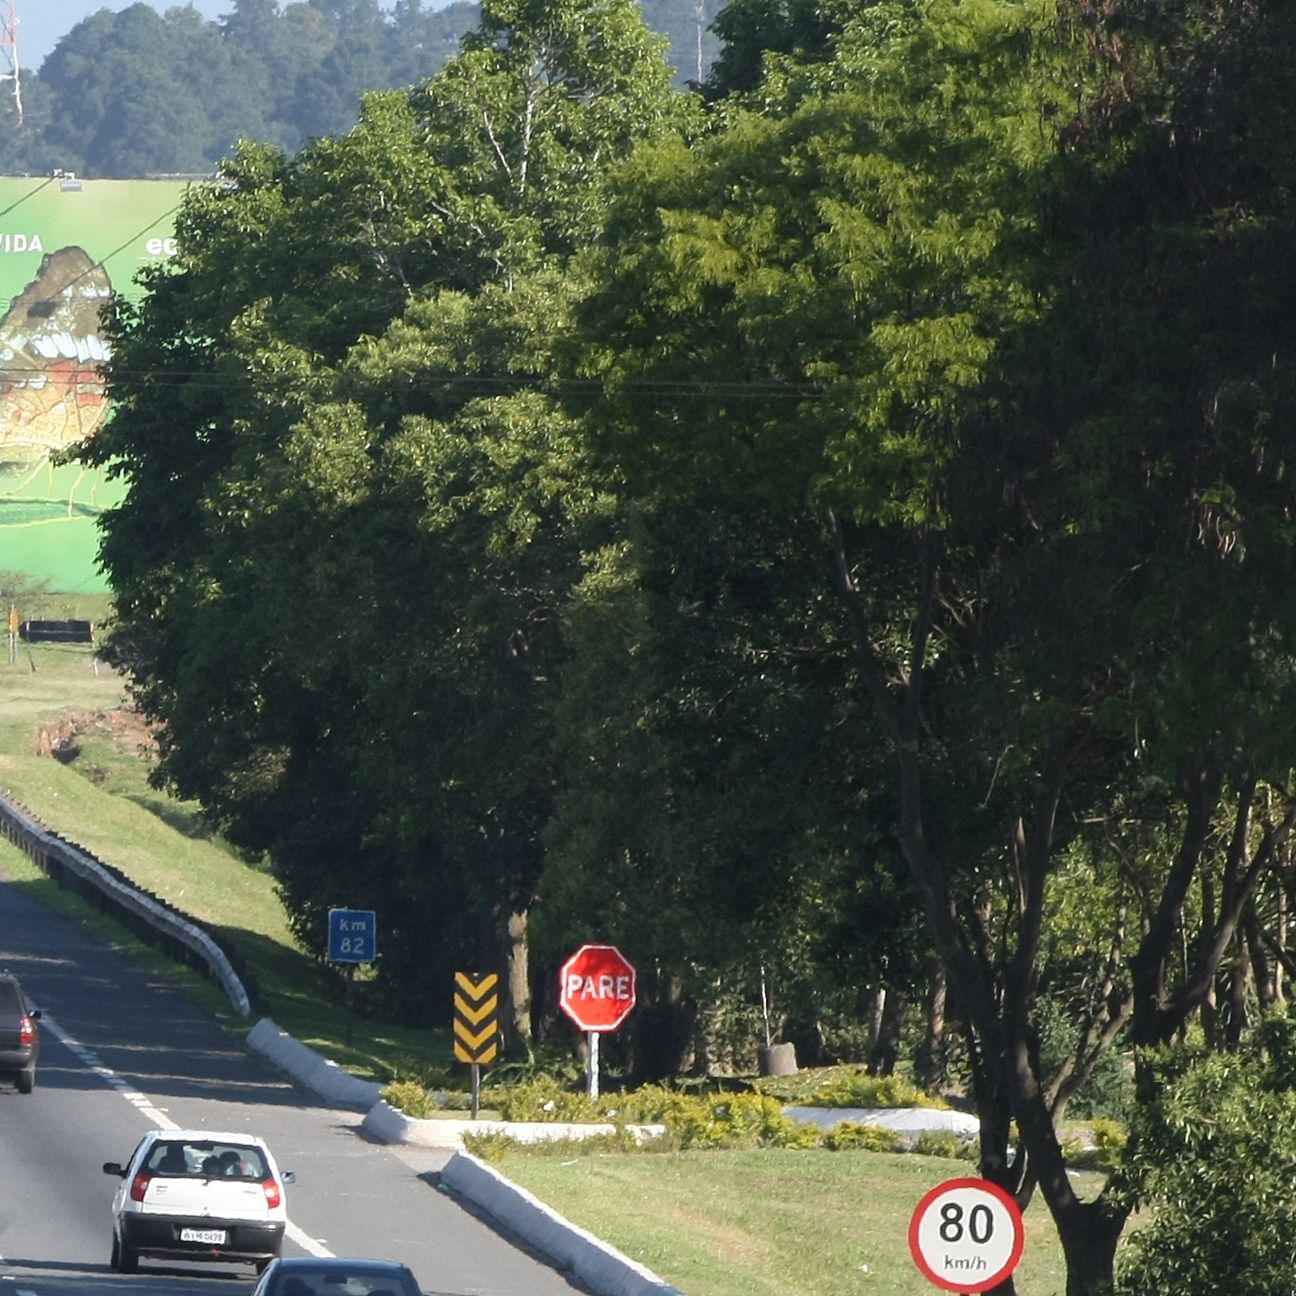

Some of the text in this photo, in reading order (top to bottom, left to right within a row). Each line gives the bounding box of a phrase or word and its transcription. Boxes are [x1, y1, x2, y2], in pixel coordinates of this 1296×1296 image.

[340, 918, 366, 931] km
[340, 937, 364, 955] 82
[567, 974, 630, 1000] PARE
[939, 1202, 994, 1244] 80
[944, 1255, 987, 1270] km/h
